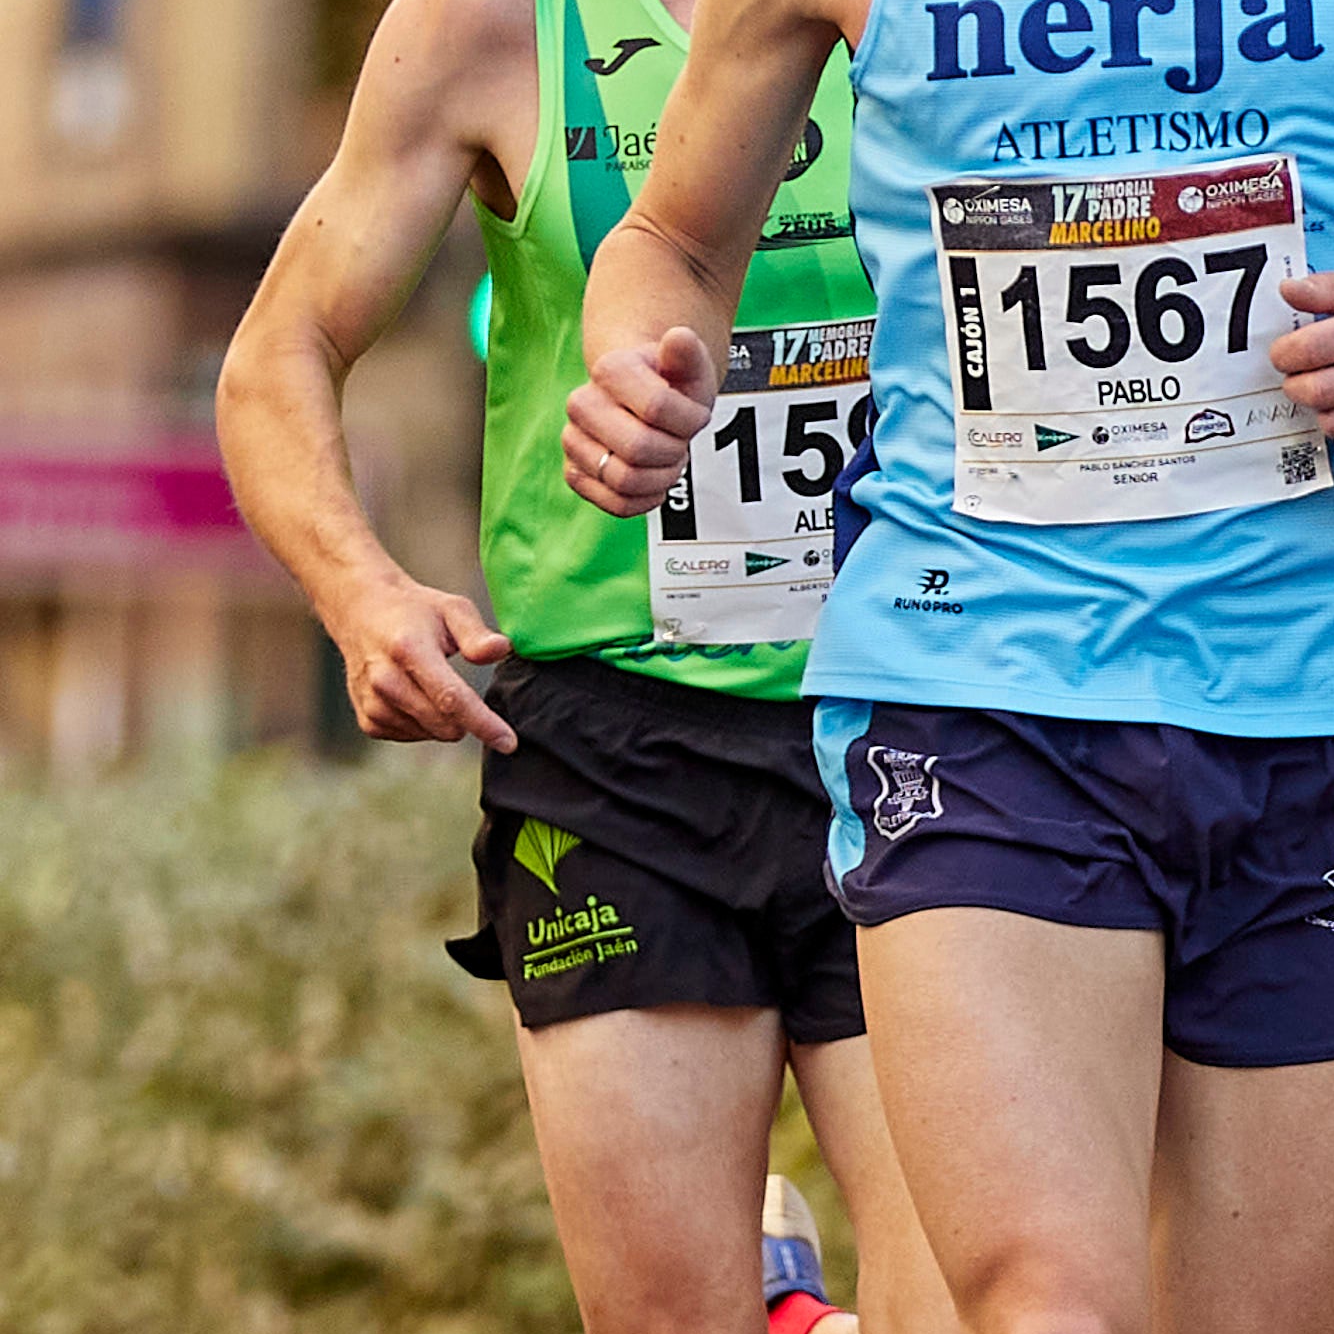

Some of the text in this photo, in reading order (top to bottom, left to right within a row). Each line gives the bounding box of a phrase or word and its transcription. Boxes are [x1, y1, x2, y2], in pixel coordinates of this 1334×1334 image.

[993, 108, 1270, 163] ATLETISMO
[1052, 179, 1156, 223] 17 MEMORIAL
[1204, 174, 1284, 198] OXIMESA
[963, 198, 1032, 213] OXIMESA
[1087, 196, 1152, 222] PADRE
[1048, 216, 1162, 245] MARCELINO
[1000, 242, 1270, 372] 1567
[772, 330, 807, 366] 17
[807, 321, 873, 344] MEMORIAL
[808, 337, 868, 364] PADRE
[960, 307, 985, 379] CAJÓN
[1099, 375, 1181, 407] PABLO
[973, 432, 1023, 443] CALERO
[1111, 422, 1168, 436] OXIMESA
[1113, 472, 1159, 485] SENIOR
[527, 895, 620, 946] Unicaja
[524, 937, 638, 981] Fundación Jaén
